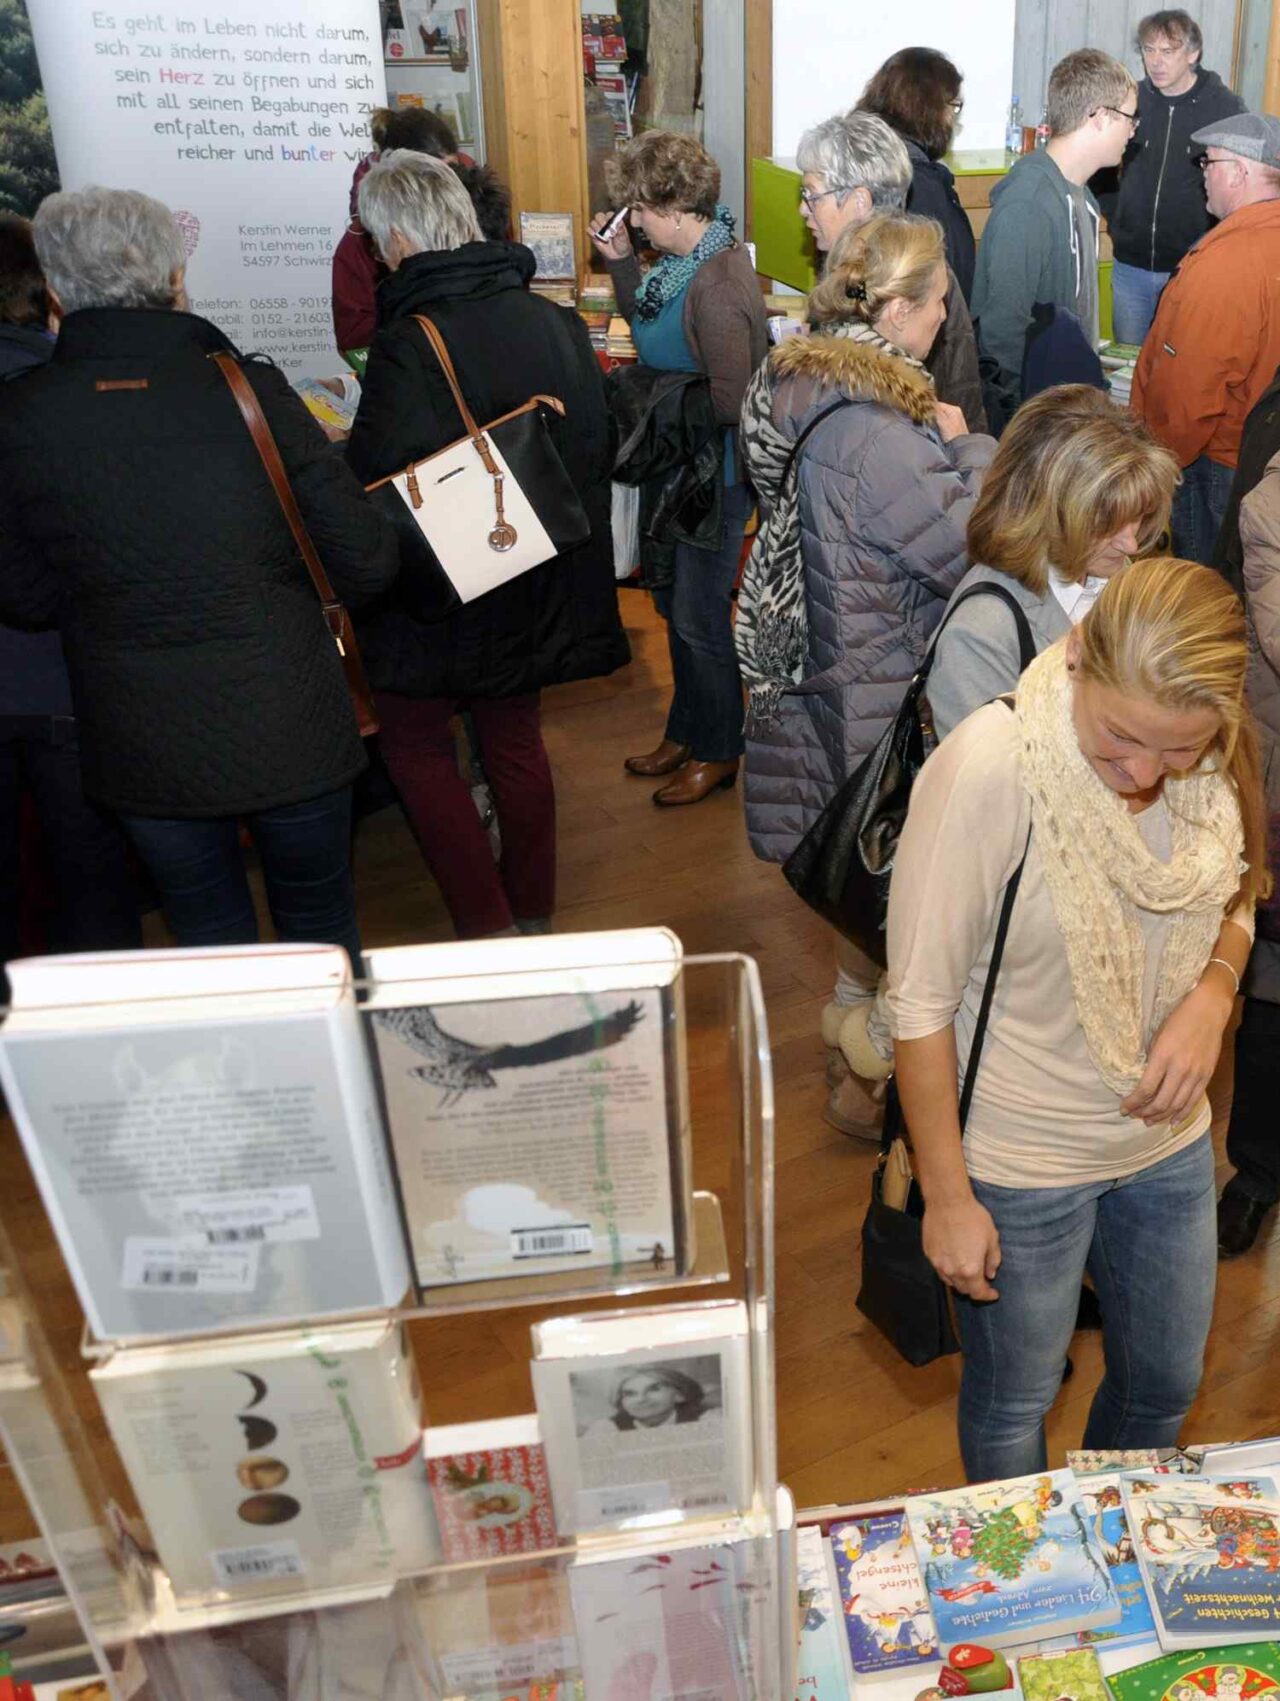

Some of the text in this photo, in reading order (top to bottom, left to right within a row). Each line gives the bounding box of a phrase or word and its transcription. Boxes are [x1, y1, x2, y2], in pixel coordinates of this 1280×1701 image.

[92, 11, 370, 42] Es geht im Leben nicht darum,
[94, 39, 372, 67] sich zu ändern, sondern darum,
[115, 67, 374, 92] sein Herz zu öffnen und sich
[116, 91, 148, 109] mit
[156, 93, 180, 109] all
[188, 94, 244, 112] seinen
[251, 96, 349, 118] Begabungen
[154, 117, 373, 140] entfalten, damit die Wel
[177, 143, 374, 162] reicher und bunter wir
[239, 224, 332, 236] Kerstin Werner
[240, 239, 332, 251] Im Lehmen 16
[243, 256, 280, 267] 54597
[250, 298, 288, 310] 06558
[252, 313, 282, 325] 0152
[880, 1578, 923, 1592] kleine
[1031, 1595, 1075, 1611] Lieder
[1076, 1585, 1102, 1605] 24
[1182, 1590, 1276, 1606] Weihnachtszeit
[952, 1604, 1010, 1629] Gedichte
[1011, 1600, 1031, 1618] und
[1197, 1605, 1271, 1621] Geschichten
